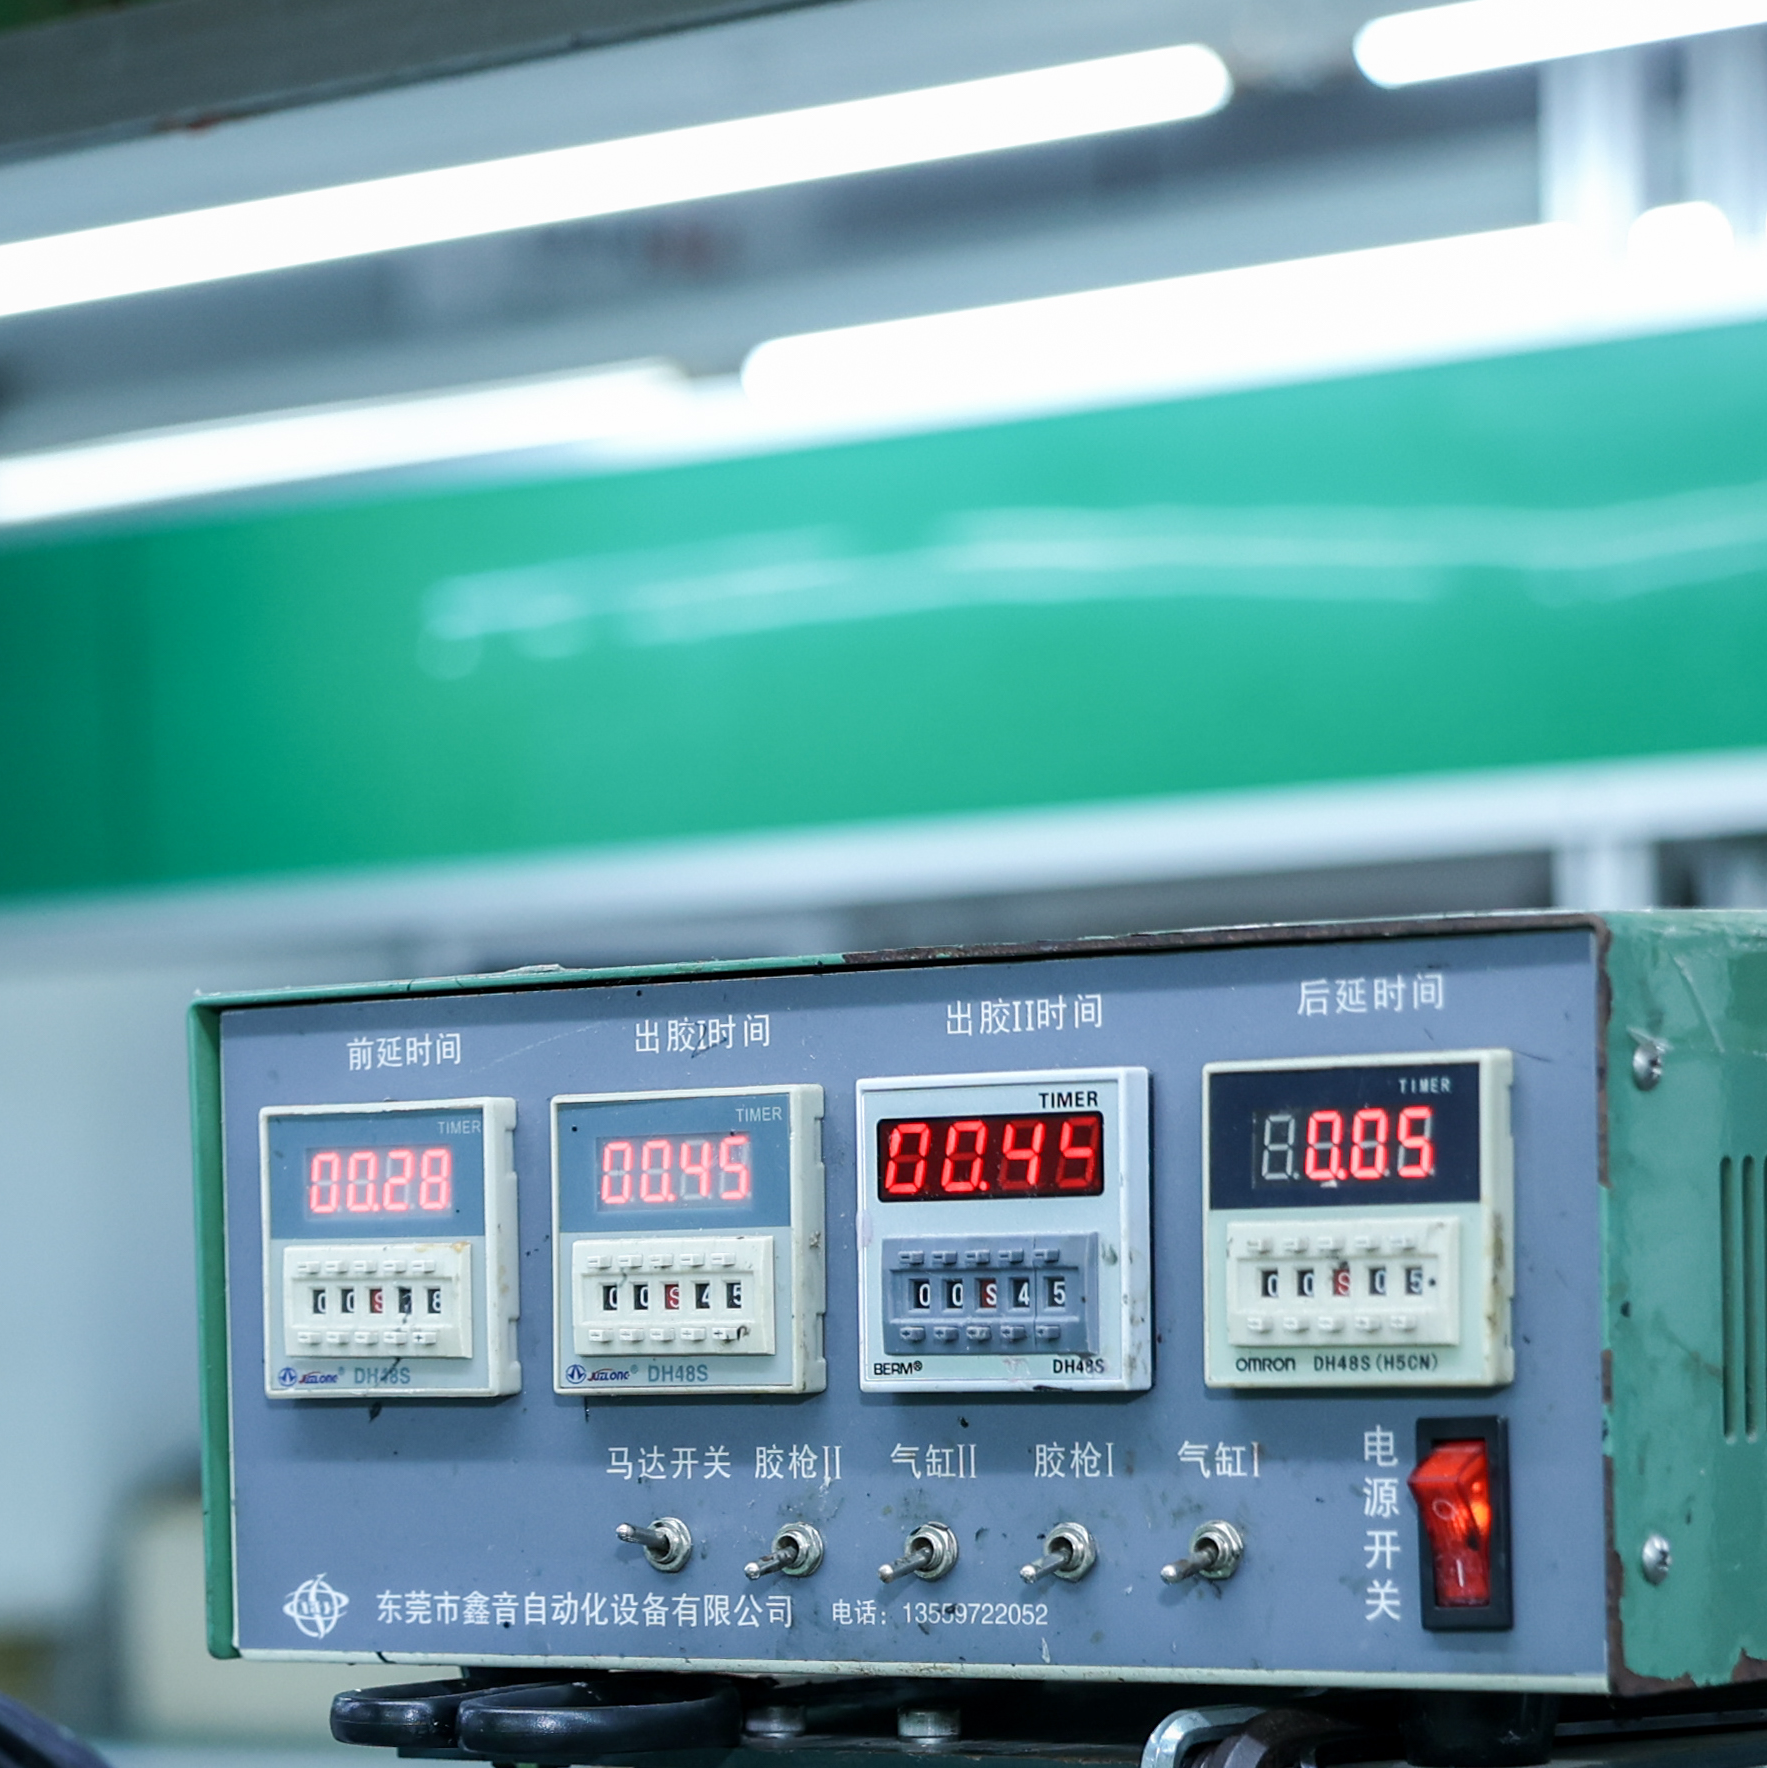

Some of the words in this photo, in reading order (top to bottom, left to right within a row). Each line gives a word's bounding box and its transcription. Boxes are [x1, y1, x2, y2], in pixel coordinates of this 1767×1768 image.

[1297, 973, 1444, 1016] 后延时间
[946, 993, 1103, 1036] 出胶II时间
[346, 1033, 461, 1071] 前延时间
[1039, 1091, 1098, 1109] TIMER
[1399, 1077, 1452, 1094] TIMER
[437, 1119, 482, 1135] TIMER
[735, 1106, 782, 1123] TIMER
[310, 1149, 452, 1213] 00.28
[601, 1134, 752, 1205] 00.45
[648, 1364, 709, 1383] DH48S
[1052, 1359, 1105, 1374] DH48S
[606, 1446, 732, 1480] 马达开关
[754, 1444, 843, 1480] 胶枪II
[890, 1442, 978, 1480] 气缸II
[1033, 1441, 1115, 1479] 胶枪I
[1177, 1440, 1261, 1479] 气缸I
[1362, 1424, 1402, 1622] 电源开关
[376, 1589, 794, 1629] 东莞市鑫音自动化设备有限公司
